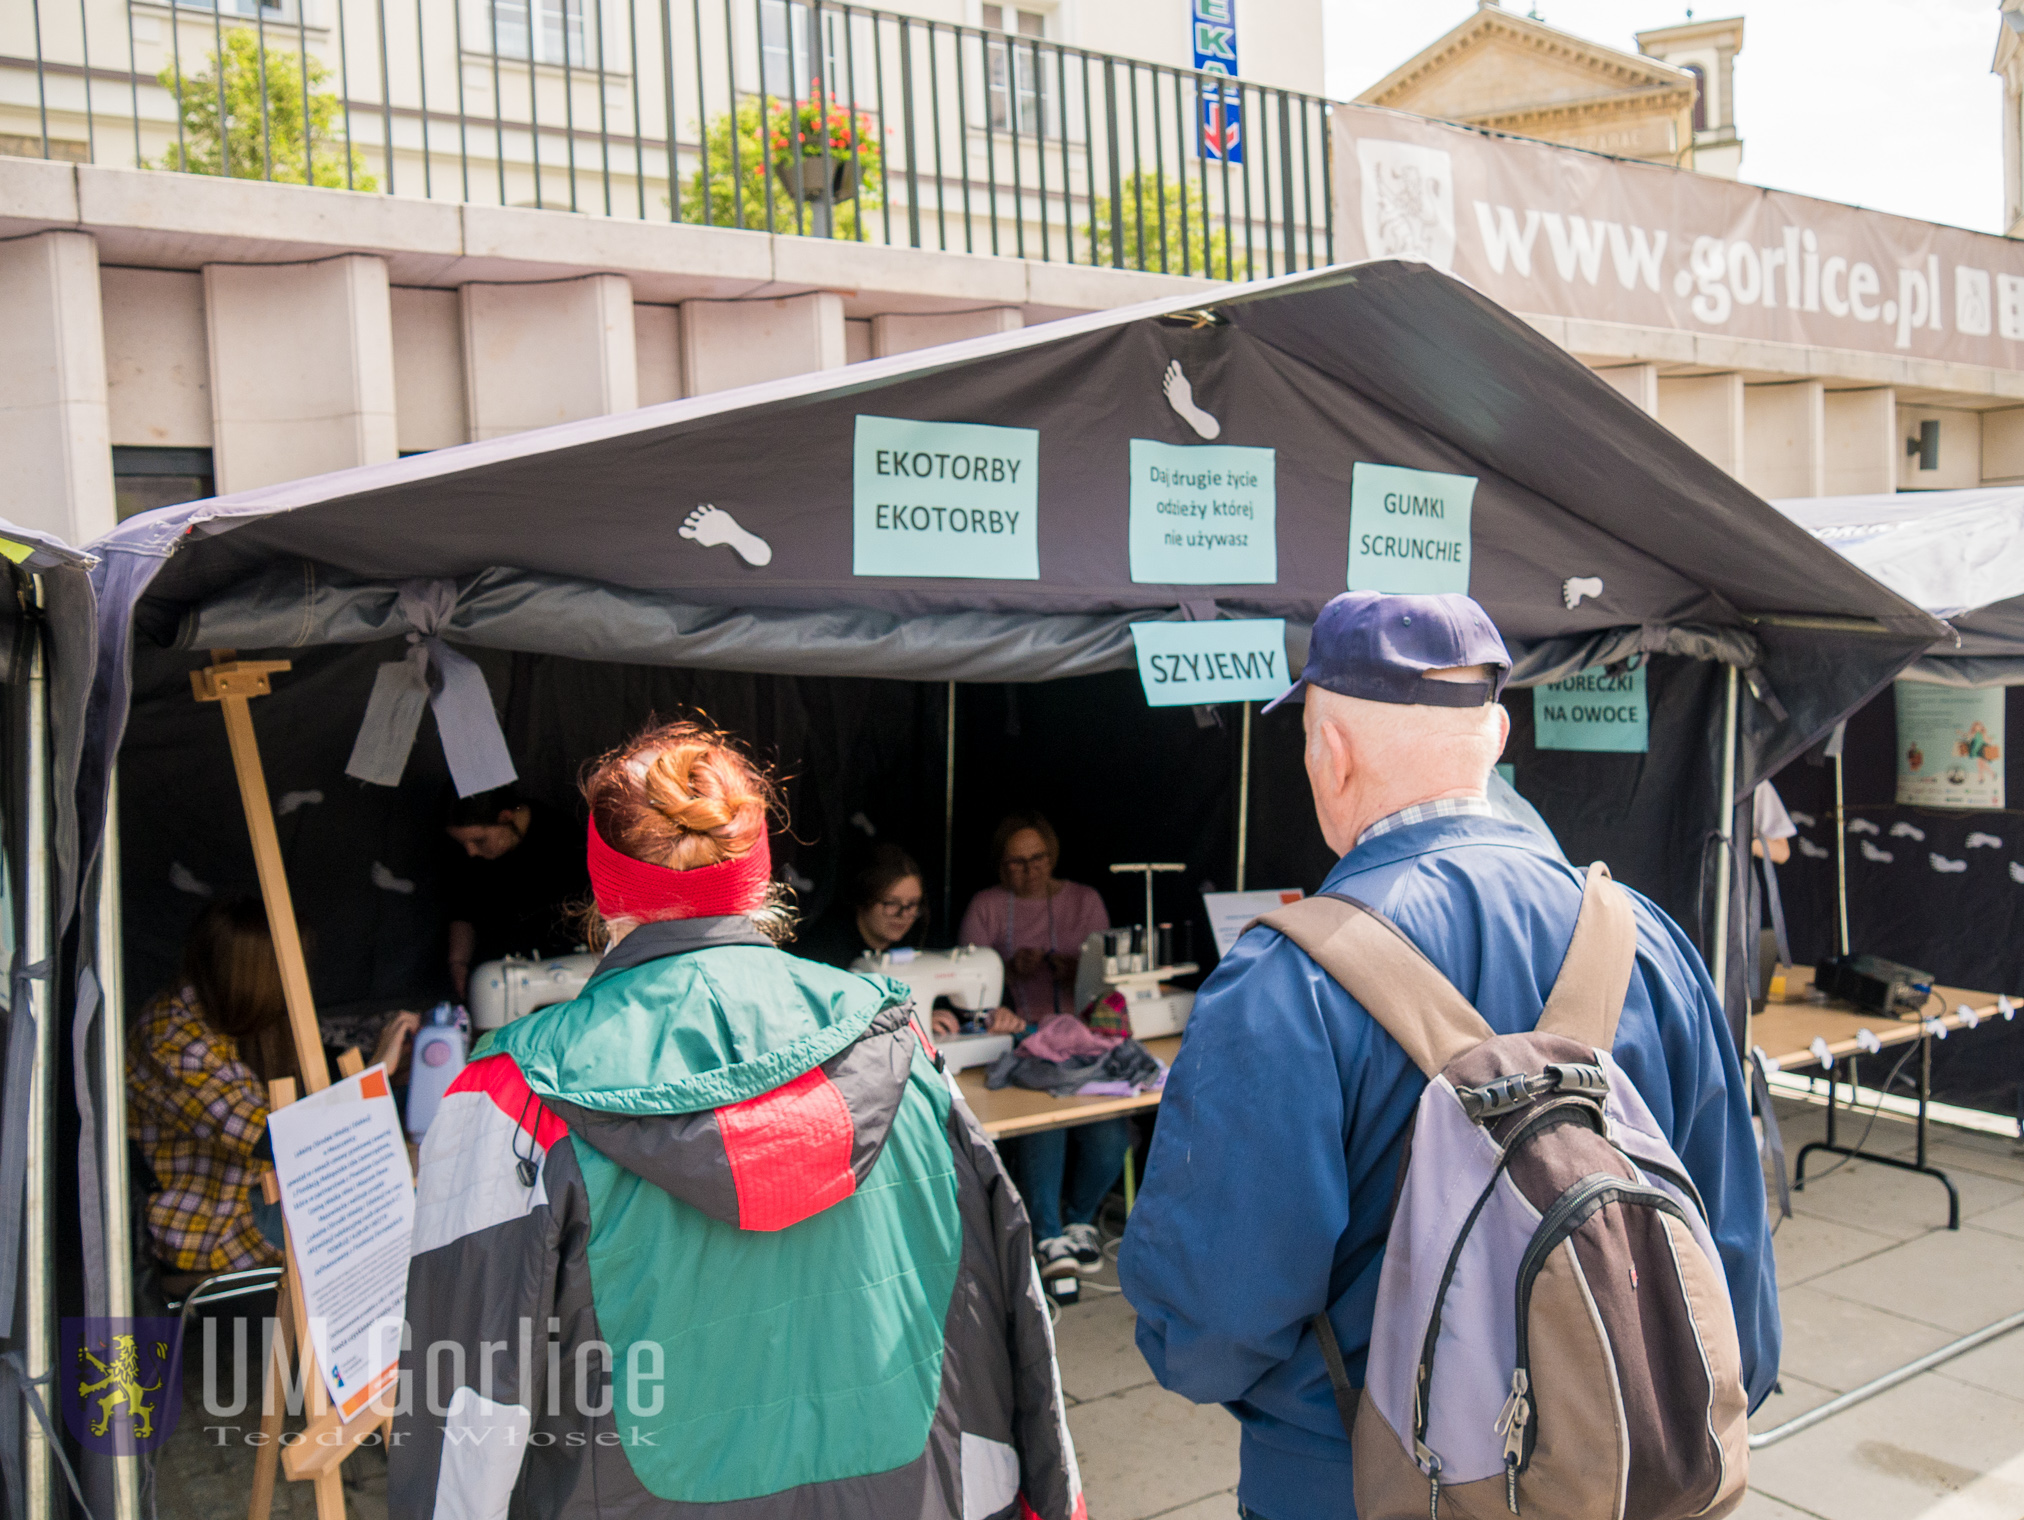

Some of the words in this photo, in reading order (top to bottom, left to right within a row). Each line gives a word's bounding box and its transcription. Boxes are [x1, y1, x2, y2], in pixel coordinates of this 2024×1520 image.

[1473, 200, 1943, 349] www.gorlice.pl
[876, 450, 1021, 484] EKOTORBY
[1150, 466, 1170, 488] Daj
[1171, 470, 1222, 490] drugie
[1226, 469, 1258, 489] życie
[875, 504, 1019, 535] EKOTORBY
[1156, 499, 1207, 520] odzieży
[1212, 499, 1254, 520] której
[1384, 492, 1444, 519] GUMKI
[1164, 529, 1183, 546] nie
[1186, 530, 1249, 550] używasz
[1360, 534, 1462, 563] SCRUNCHIE
[1151, 651, 1275, 683] SZYJEMY
[1543, 706, 1567, 722] NA
[1571, 705, 1639, 723] OWOCE
